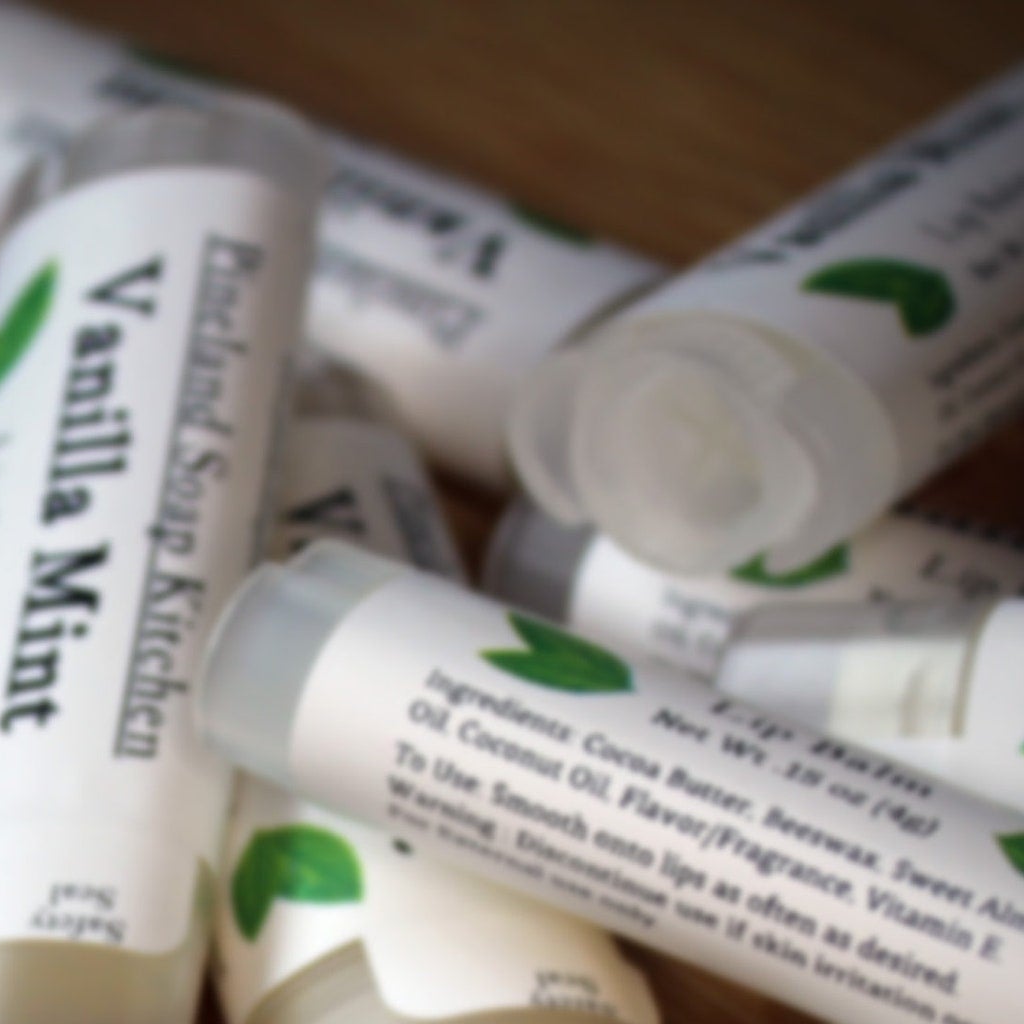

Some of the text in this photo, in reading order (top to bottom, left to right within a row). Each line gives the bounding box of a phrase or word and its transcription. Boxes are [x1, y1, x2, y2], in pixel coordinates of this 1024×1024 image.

[41, 253, 166, 525] Vanilla
[148, 448, 230, 554] Soap
[119, 576, 207, 759] Kitchen
[395, 741, 427, 772] To
[491, 782, 589, 842] Smooth
[593, 830, 656, 868] onto
[659, 850, 707, 890] lips
[713, 879, 741, 904] as
[746, 893, 817, 937] often
[823, 925, 852, 950] as
[458, 719, 563, 782] Coconut
[866, 886, 974, 950] Vitamin
[582, 731, 661, 779] Cocoa
[891, 857, 974, 910] Sweet
